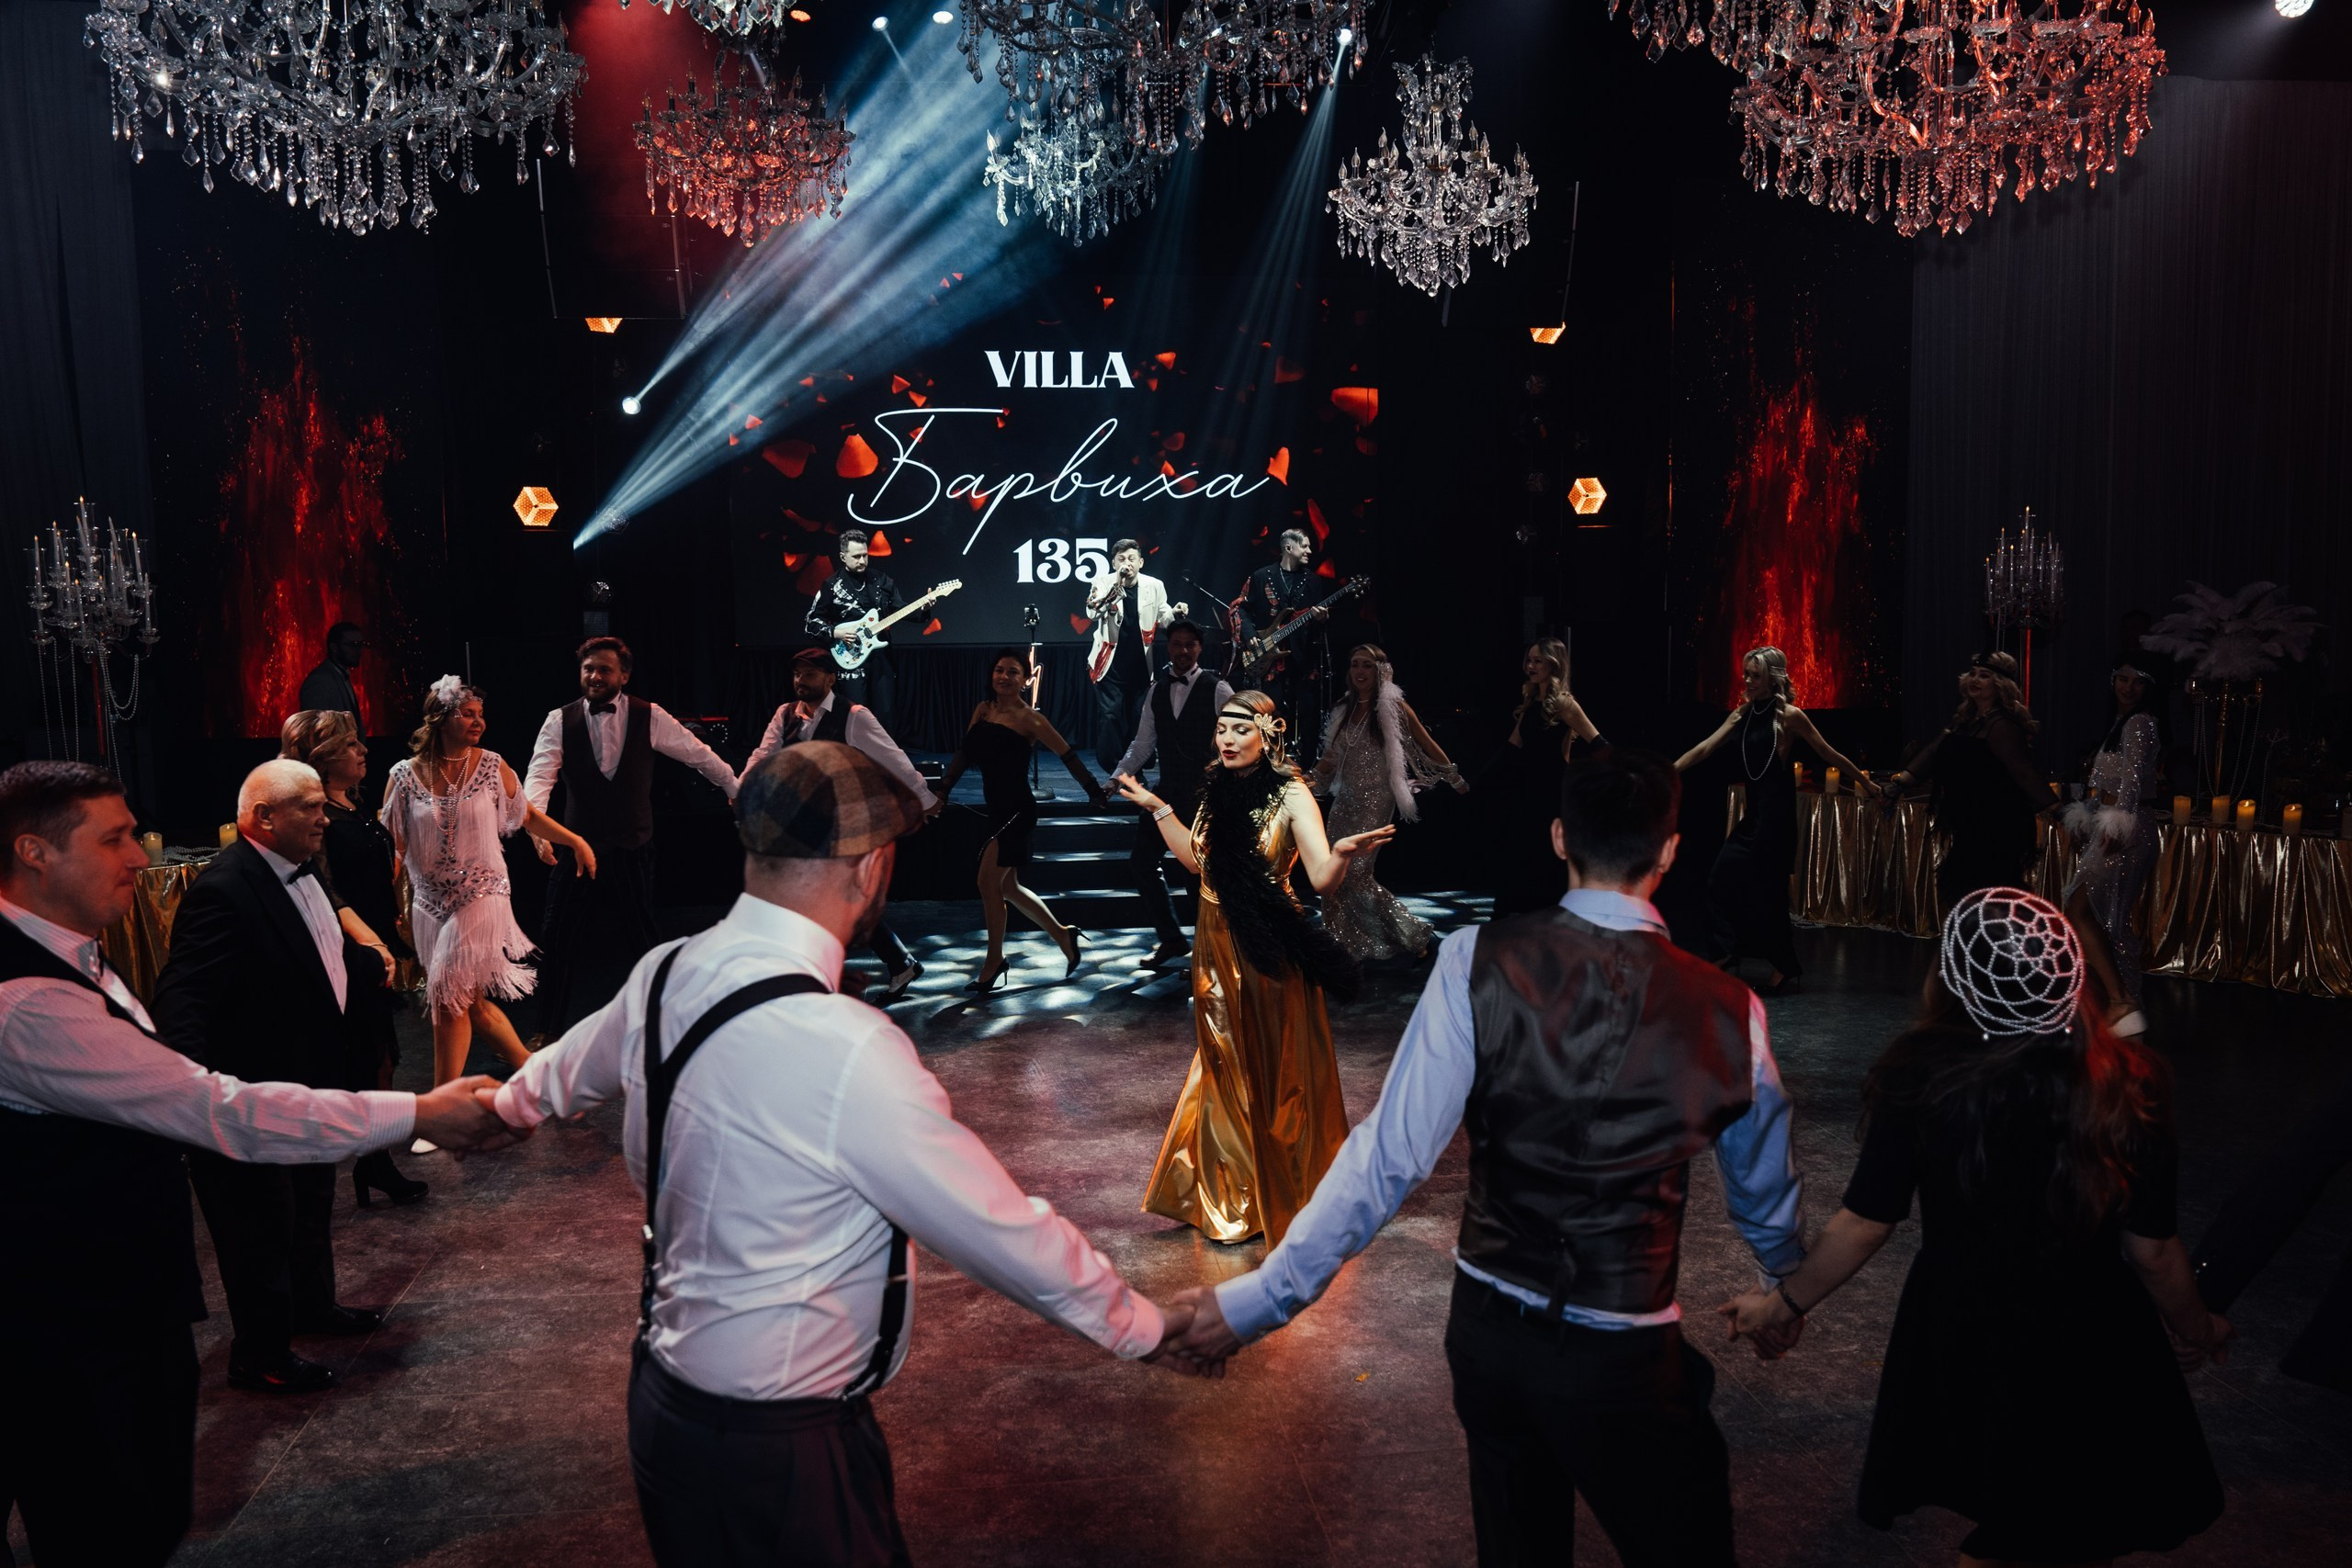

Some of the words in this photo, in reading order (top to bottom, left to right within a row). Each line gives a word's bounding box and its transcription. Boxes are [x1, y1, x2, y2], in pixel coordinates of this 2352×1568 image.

[984, 350, 1135, 389] VILLA
[847, 407, 1270, 555] Барвиха
[1012, 537, 1111, 583] 135
